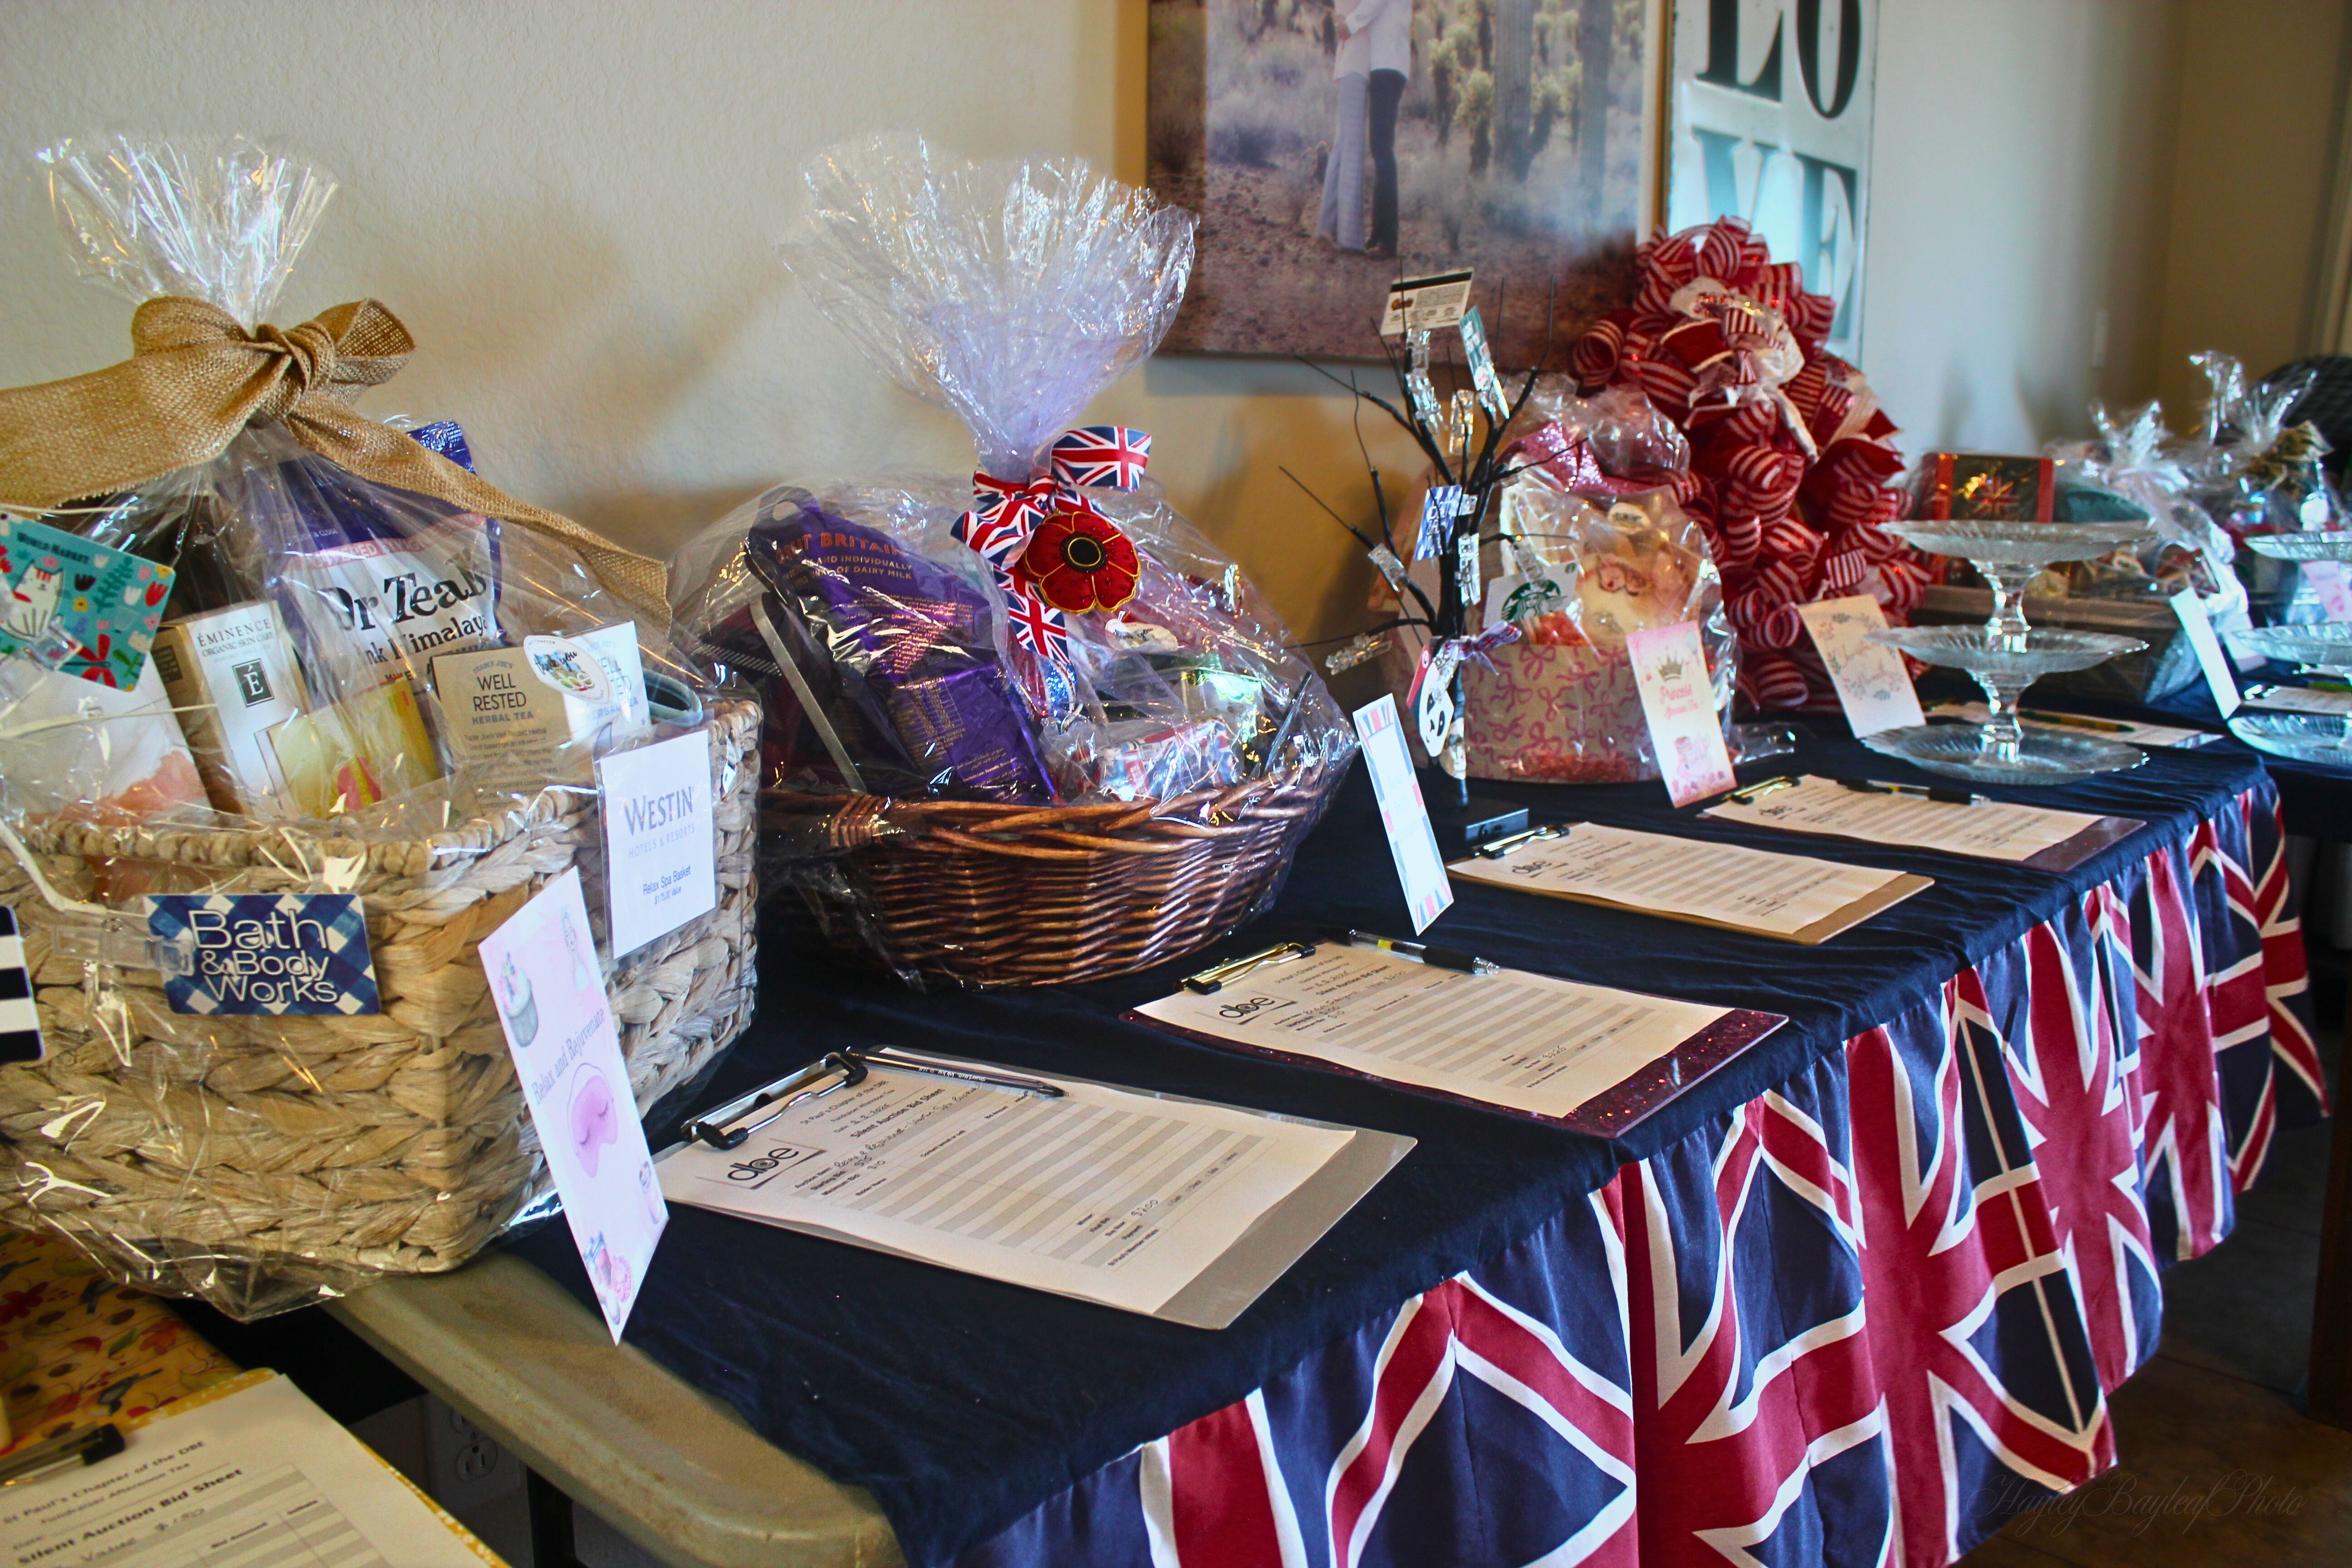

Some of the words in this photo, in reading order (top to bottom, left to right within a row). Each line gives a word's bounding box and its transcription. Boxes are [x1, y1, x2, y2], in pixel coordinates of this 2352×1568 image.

[841, 555, 912, 570] INDIVIDUALLY
[854, 566, 884, 574] DAIRY
[888, 571, 912, 579] MILK
[202, 642, 237, 657] ORGANIC
[477, 673, 516, 691] WELL
[473, 691, 526, 712] RESTED
[472, 714, 511, 725] HERBAL
[514, 711, 534, 721] TEA
[624, 785, 694, 837] WESTIN
[628, 839, 657, 859] HOTELS
[659, 837, 665, 847] &
[666, 823, 696, 843] RESORTS
[643, 882, 660, 896] Relax
[661, 875, 672, 890] Spa
[673, 865, 691, 882] Basket
[188, 908, 329, 950] Bath
[201, 950, 227, 975] &
[232, 950, 330, 981] Body
[204, 975, 339, 1003] Works
[1337, 976, 1362, 988] Auction
[1219, 997, 1277, 1019] dbe
[531, 1070, 555, 1105] Relax
[554, 1046, 568, 1078] and
[566, 1008, 605, 1061] Rejuvenate
[850, 1123, 878, 1138] Silent
[876, 1108, 910, 1125] Auction
[906, 1100, 924, 1108] Bid
[920, 1088, 946, 1101] Sheet
[727, 1147, 800, 1181] dbe
[72, 1472, 130, 1499] Chapter
[134, 1463, 148, 1474] of
[152, 1455, 176, 1466] the
[17, 1539, 77, 1565] Silent
[82, 1506, 156, 1541] Auction
[159, 1490, 190, 1508] Bid
[192, 1468, 243, 1493] Sheet
